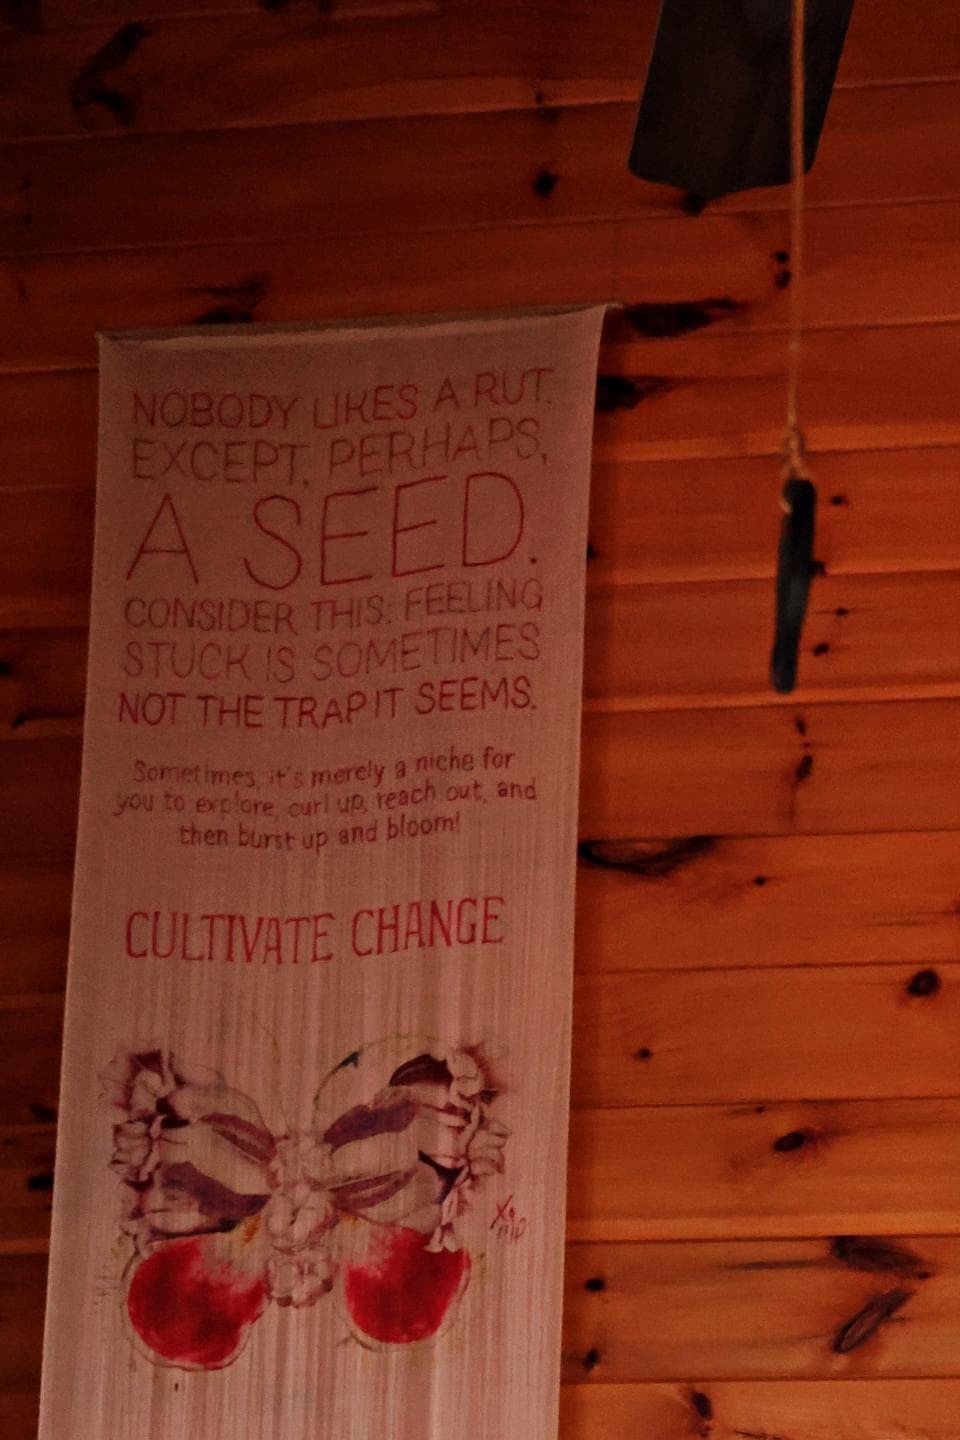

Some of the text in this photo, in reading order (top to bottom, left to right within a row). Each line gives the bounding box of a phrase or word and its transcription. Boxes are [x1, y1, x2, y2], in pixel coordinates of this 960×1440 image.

[133, 390, 302, 430] NOBODY
[313, 384, 418, 429] LIKES
[433, 377, 460, 412] A
[329, 417, 548, 479] PERHAPS,
[126, 472, 537, 590] A SEED.
[123, 595, 298, 636] CONSIDER
[405, 578, 543, 621] FEELING
[122, 622, 540, 684] STUCK IS SOMETIMES
[118, 675, 537, 730] NOT THE TRAP IT SEEMS.
[311, 760, 386, 787] merely
[395, 760, 406, 779] a
[415, 746, 474, 772] niche
[483, 746, 515, 770] for
[112, 793, 154, 817] you
[163, 792, 185, 812] to
[287, 793, 329, 818] curl
[337, 793, 368, 817] up,
[377, 780, 436, 810] reach
[446, 780, 487, 804] out,
[497, 777, 537, 801] and
[180, 811, 461, 855] then burst up and bloom!
[124, 896, 505, 965] CULTIVATE CHANGE
